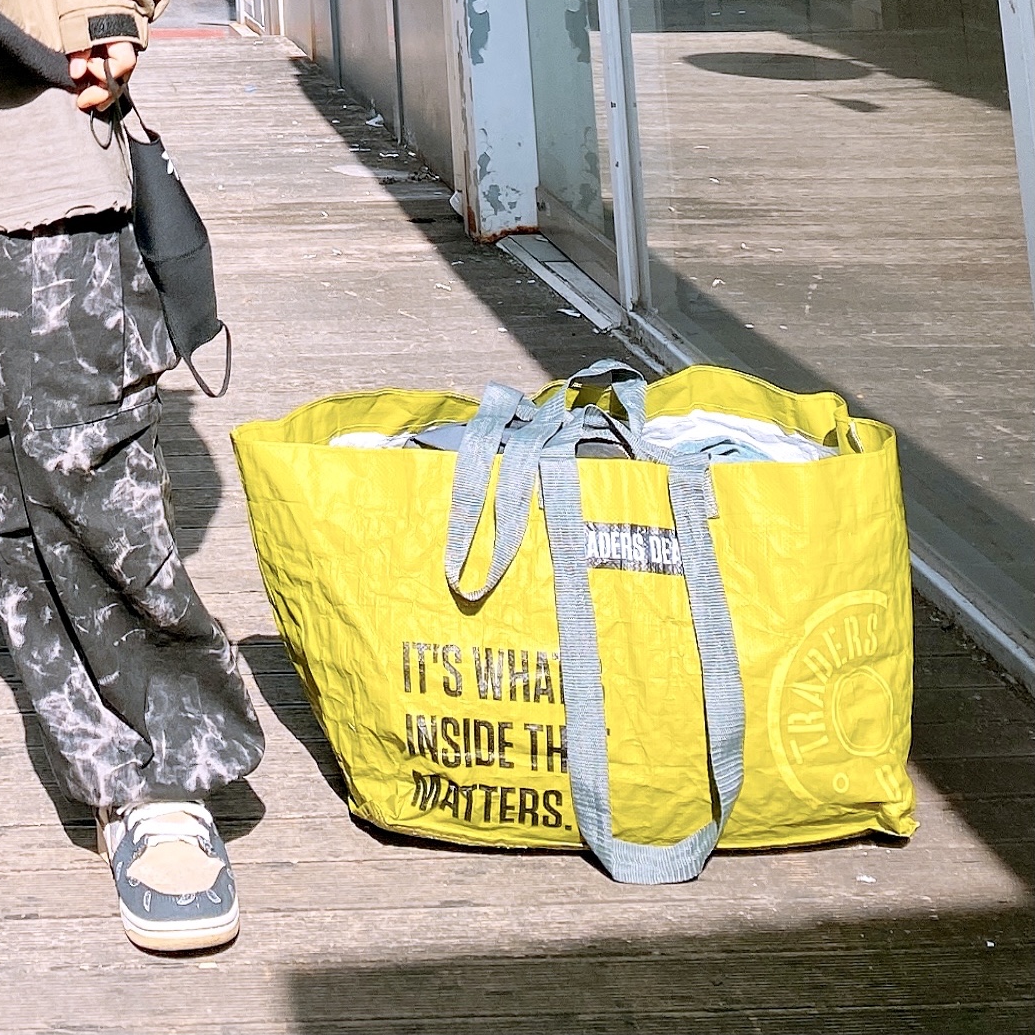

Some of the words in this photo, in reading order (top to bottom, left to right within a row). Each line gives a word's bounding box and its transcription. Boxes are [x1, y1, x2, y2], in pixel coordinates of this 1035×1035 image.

[585, 530, 646, 564] ADERS
[402, 641, 463, 698] IT'S
[472, 646, 566, 705] WHA
[787, 612, 879, 765] TRADERS
[405, 713, 515, 769] INSIDE
[411, 769, 572, 831] MATTERS.
